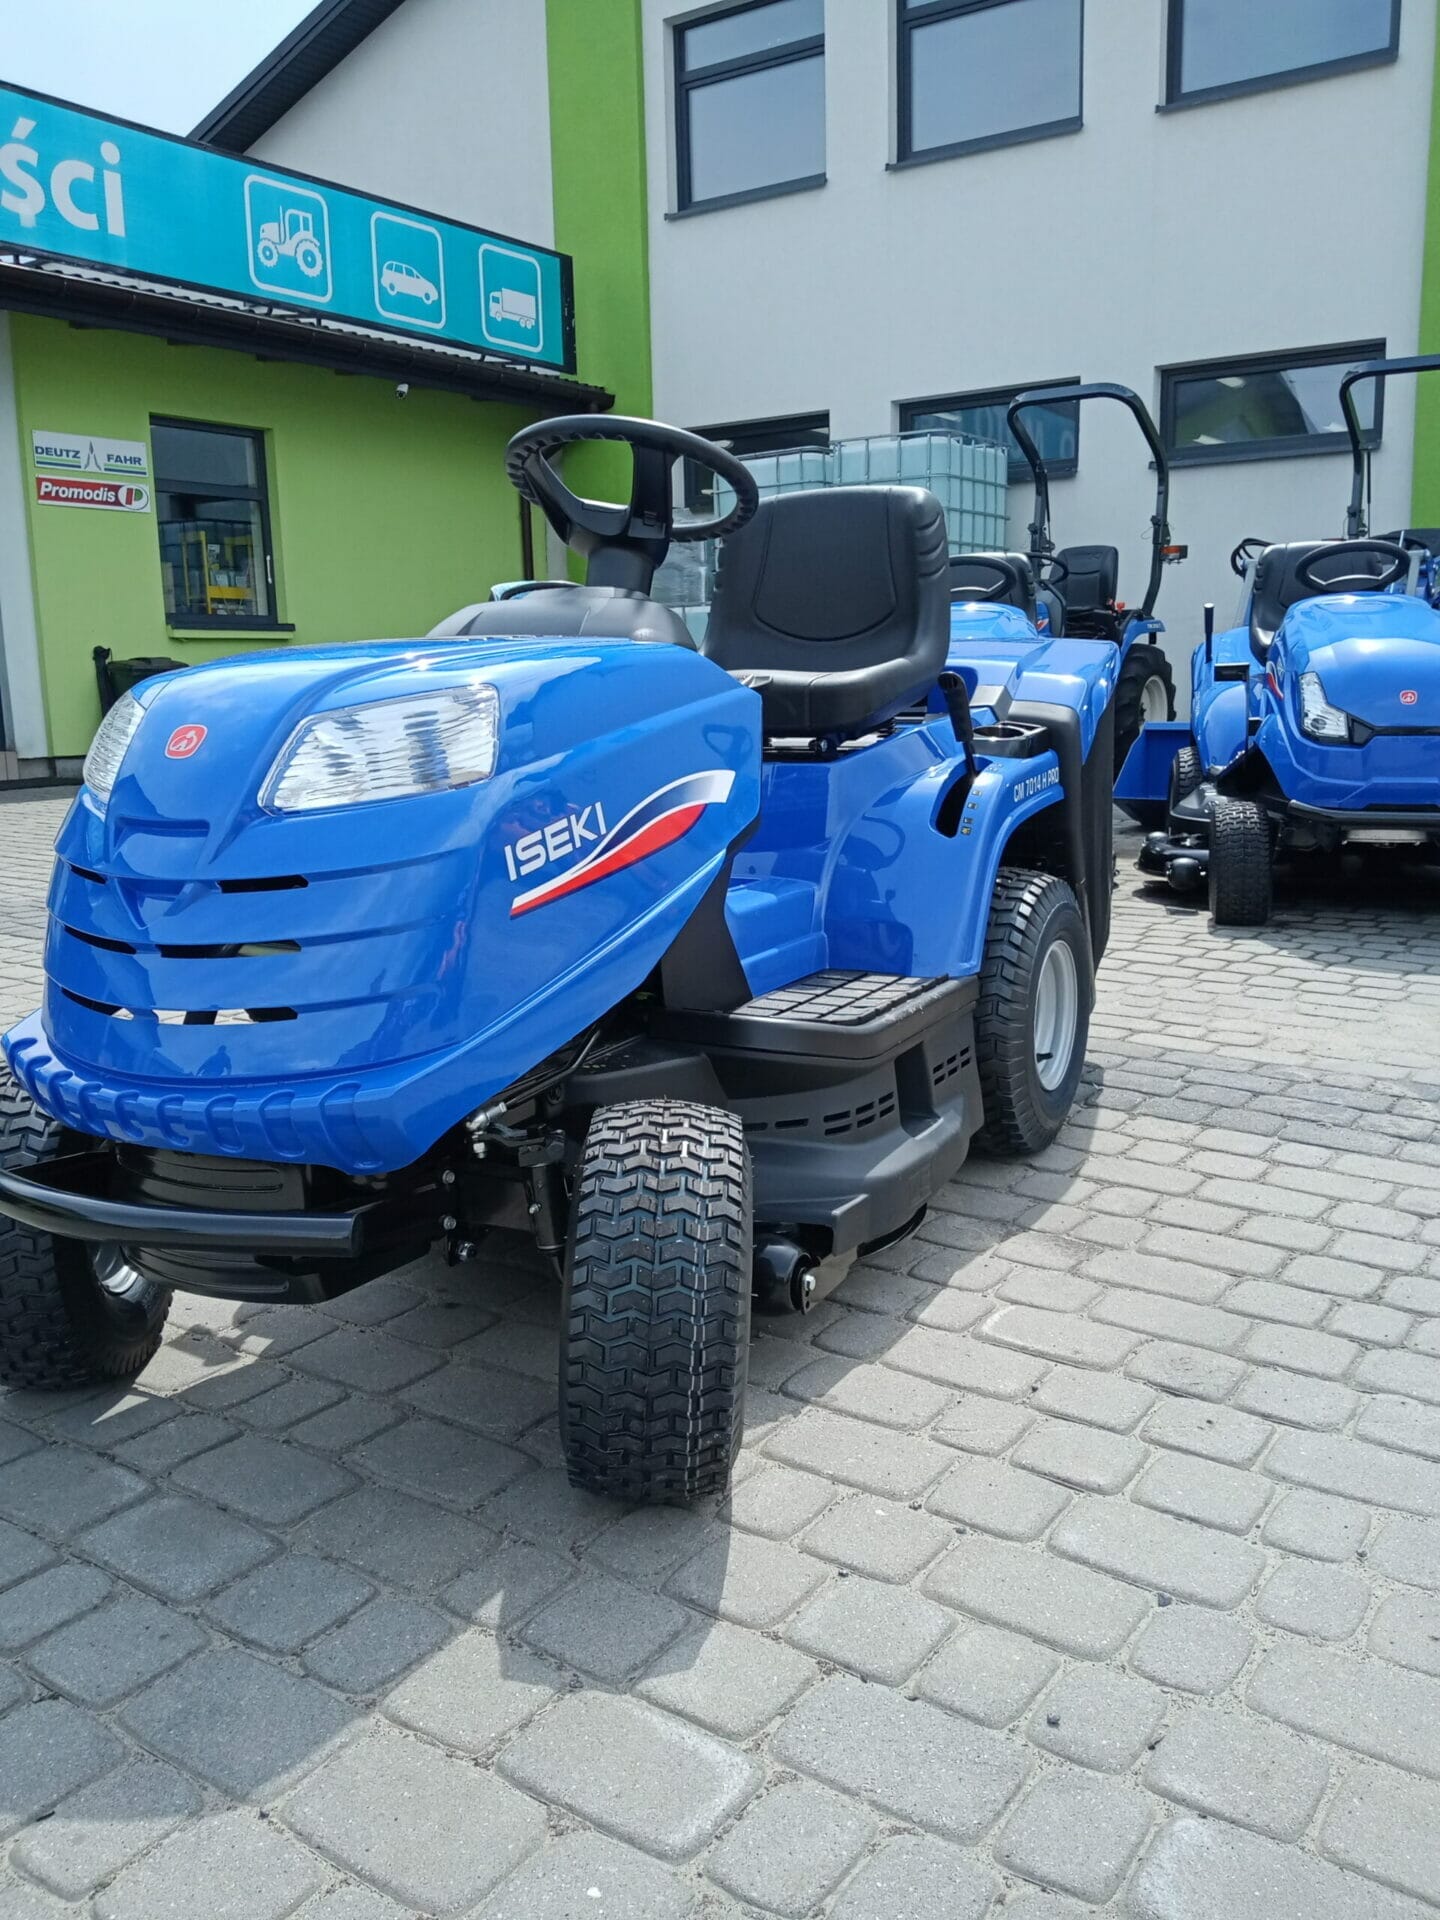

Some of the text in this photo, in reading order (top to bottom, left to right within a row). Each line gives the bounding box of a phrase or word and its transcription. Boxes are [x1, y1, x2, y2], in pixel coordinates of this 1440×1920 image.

[35, 445, 142, 466] DEUTZ FAHR
[40, 481, 116, 503] Promodis
[1025, 774, 1042, 797] 7014
[1041, 771, 1048, 789] H
[1047, 766, 1060, 787] PRO
[504, 801, 608, 882] ISEKI
